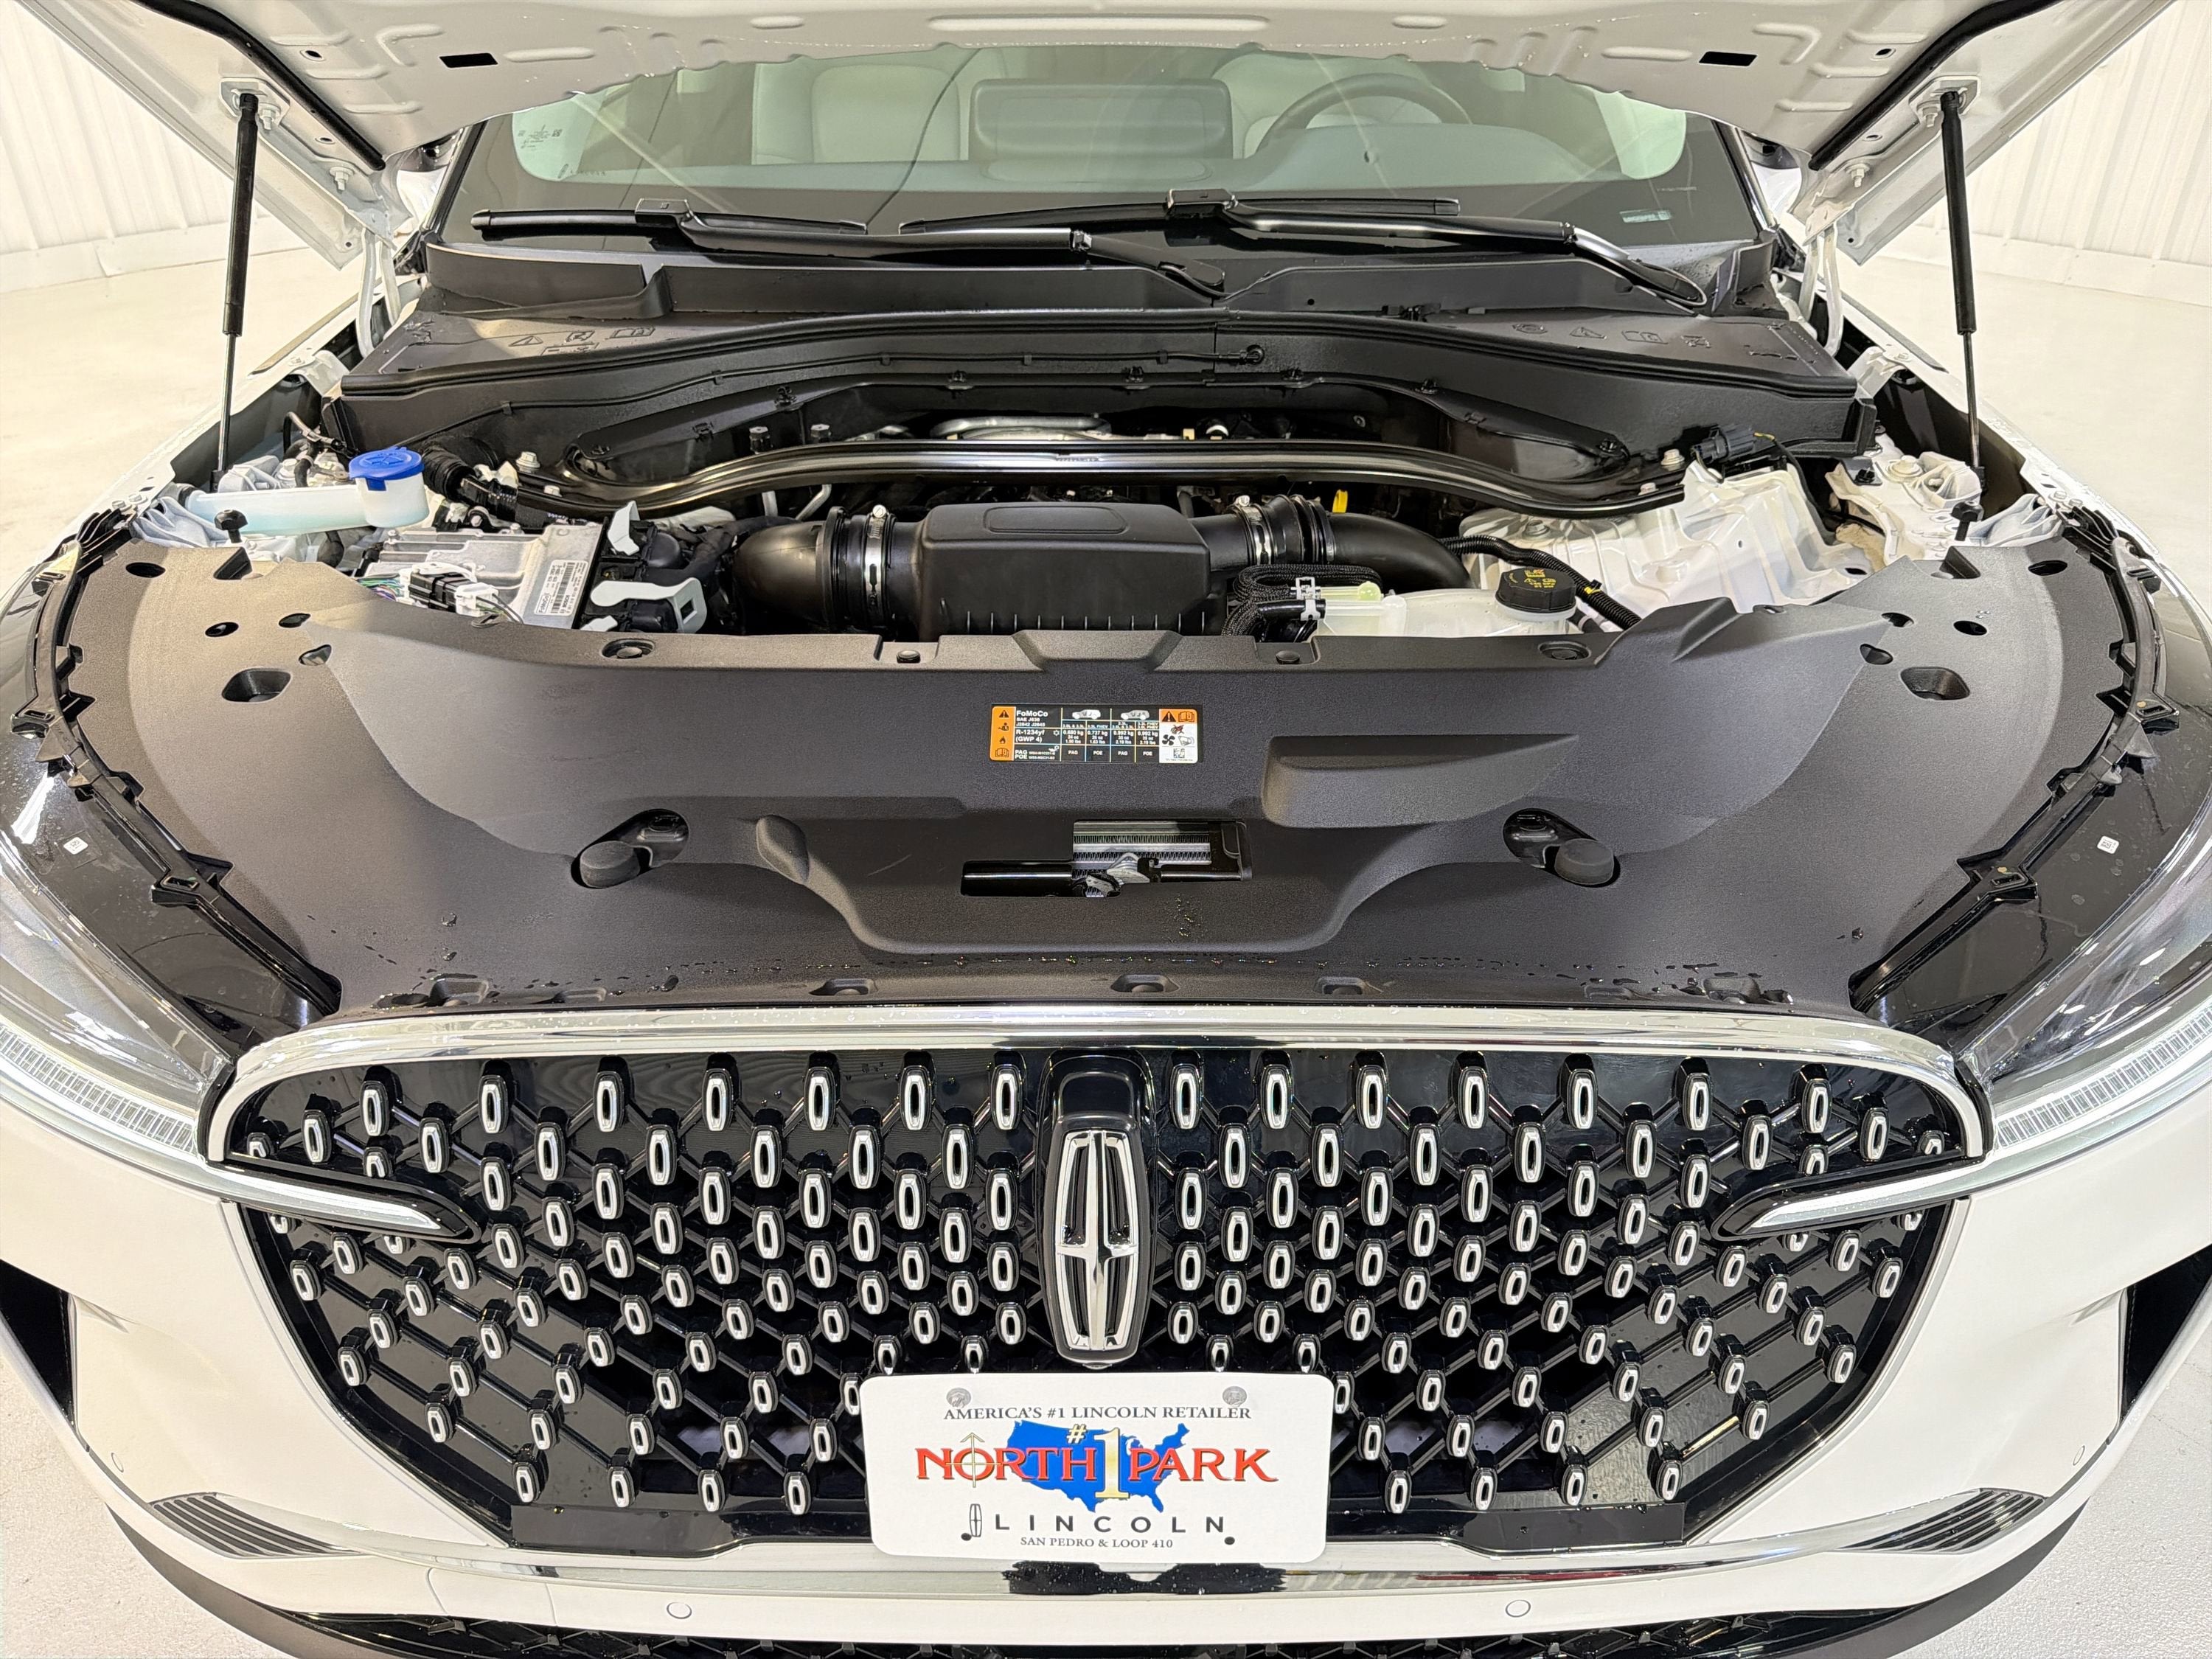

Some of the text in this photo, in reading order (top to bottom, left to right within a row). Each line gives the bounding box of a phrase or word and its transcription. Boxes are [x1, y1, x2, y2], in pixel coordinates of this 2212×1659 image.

[944, 1406, 1251, 1419] AMERICA'S #1 LINCOLN RETAILER
[915, 1447, 1279, 1482] NORTH PARK
[995, 1514, 1224, 1534] LINCOLN
[1020, 1537, 1173, 1548] SAN PEDRO & LOOP 410
